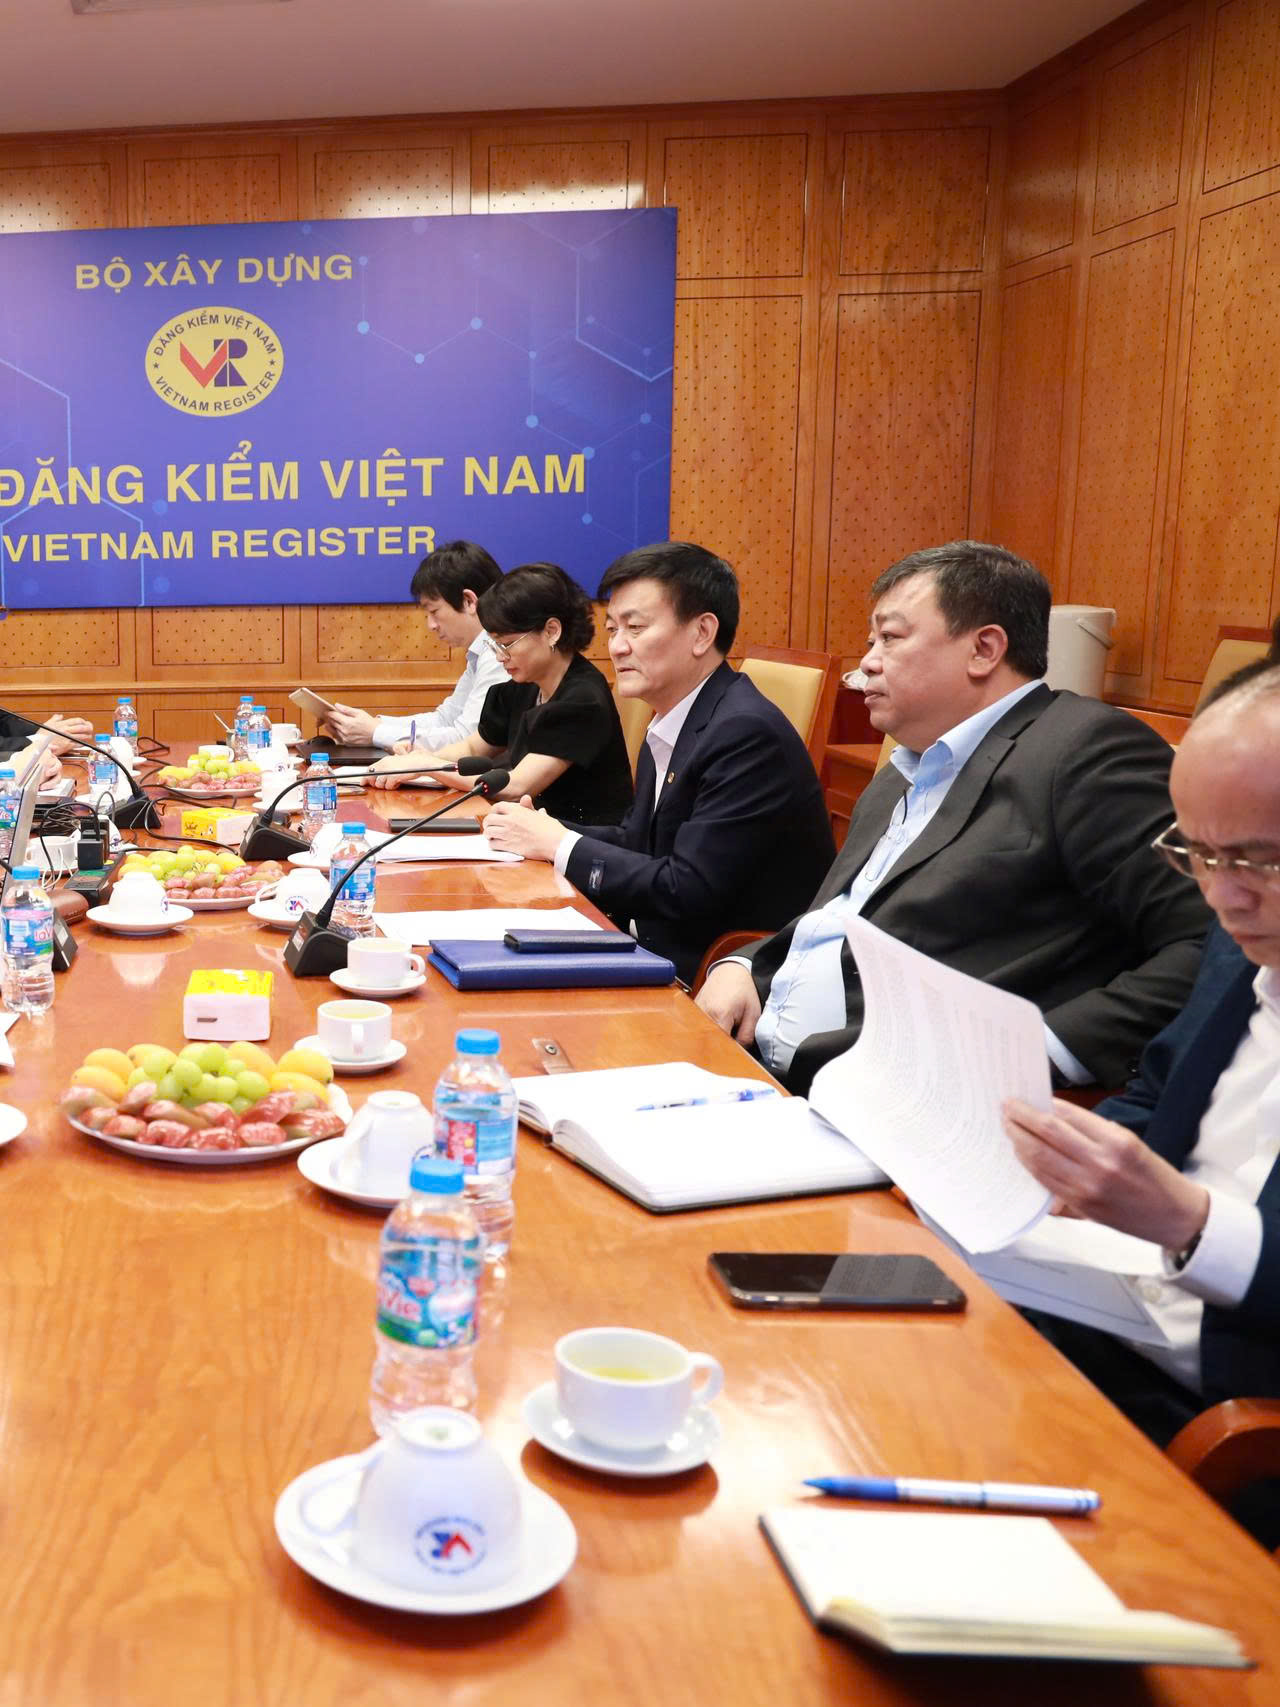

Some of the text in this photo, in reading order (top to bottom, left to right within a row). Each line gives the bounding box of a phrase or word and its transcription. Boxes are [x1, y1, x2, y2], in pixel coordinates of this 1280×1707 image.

[75, 253, 353, 293] BỘ XÂY DỰNG
[186, 310, 220, 329] KIỂM
[223, 314, 253, 330] VIỆT
[253, 327, 277, 355] NAM
[155, 371, 276, 412] VIETNAM REGISTER
[167, 440, 299, 502] KIỂM
[320, 447, 445, 507] VIỆT
[463, 453, 585, 496] NAM
[2, 526, 436, 562] VIETNAM REGISTER
